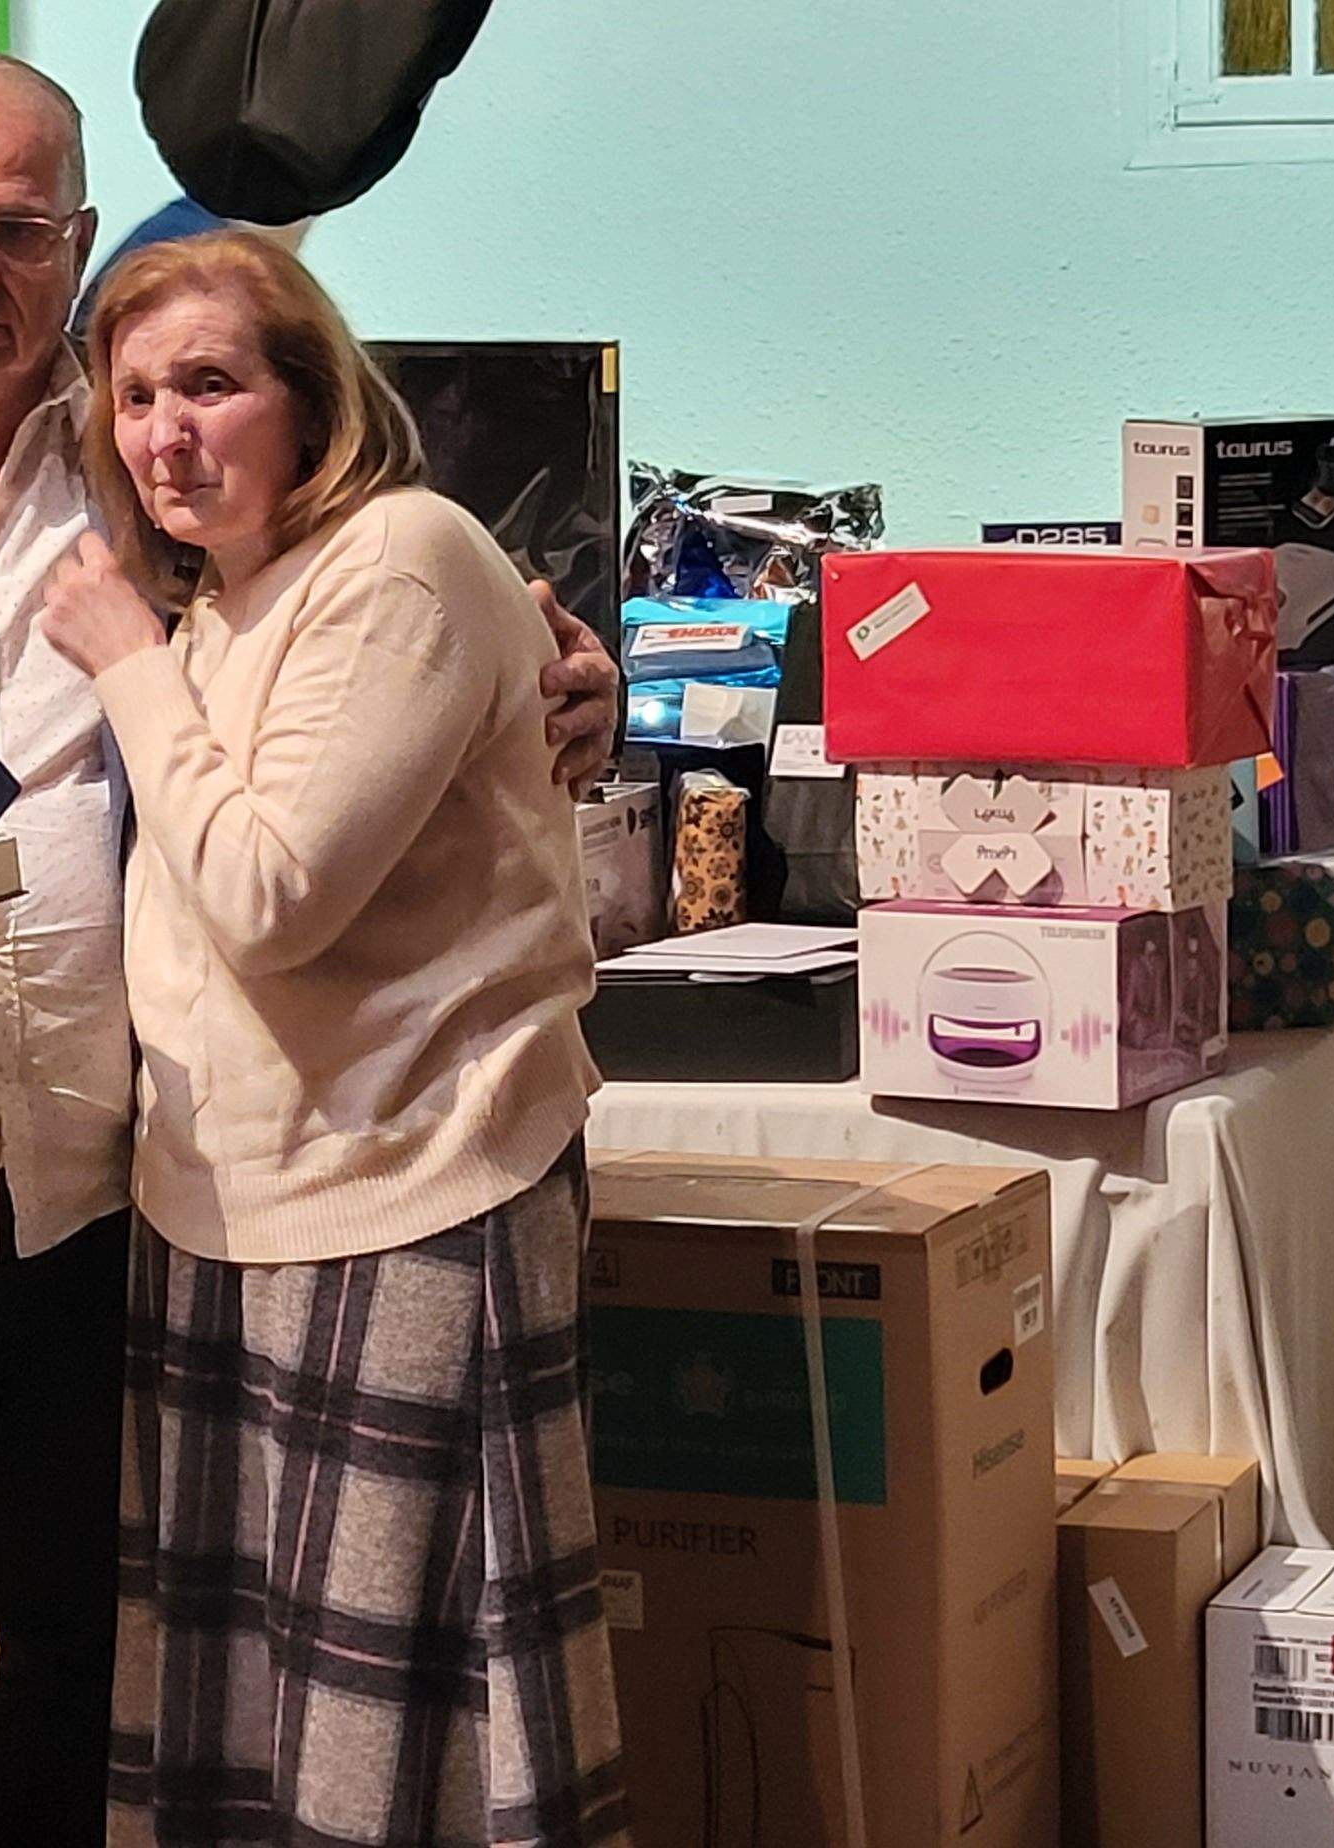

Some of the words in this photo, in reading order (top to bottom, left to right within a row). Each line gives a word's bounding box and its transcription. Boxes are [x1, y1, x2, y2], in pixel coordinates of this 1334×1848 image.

[1133, 441, 1191, 456] taurus
[1216, 440, 1294, 458] taurus
[785, 1266, 865, 1296] FONT
[613, 1515, 759, 1557] PURIFIER
